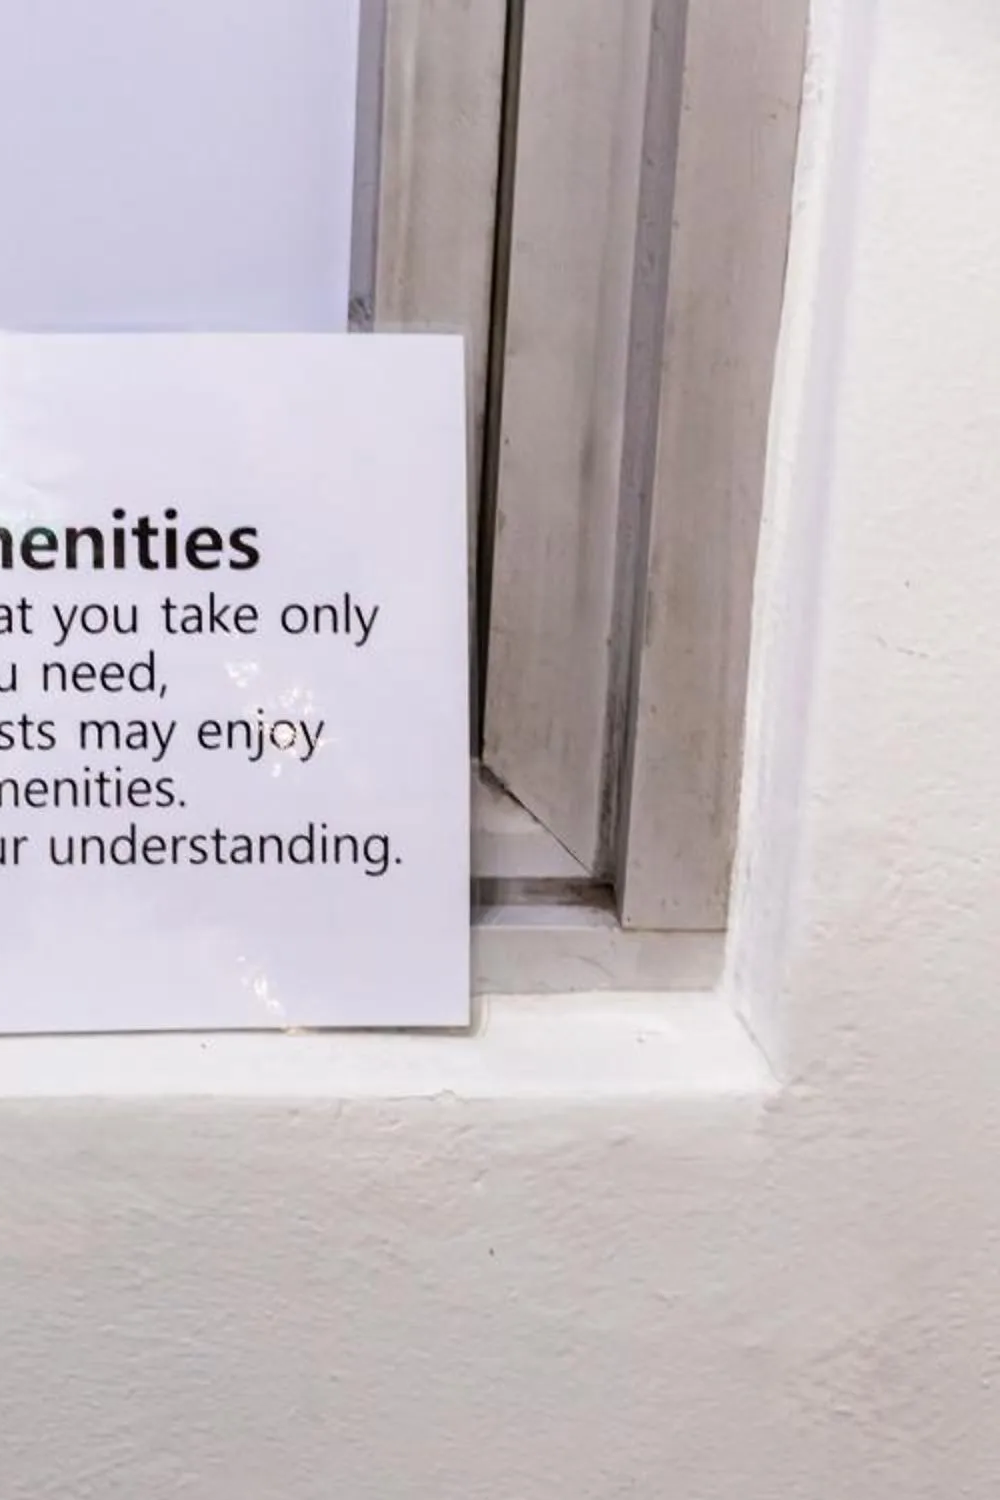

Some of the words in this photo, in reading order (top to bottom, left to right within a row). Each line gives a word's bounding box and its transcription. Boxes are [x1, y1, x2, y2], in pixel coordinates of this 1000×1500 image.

[52, 603, 138, 647] you
[160, 591, 259, 636] take
[280, 591, 379, 647] only
[42, 650, 167, 699] need,
[79, 719, 177, 763] may
[197, 708, 325, 763] enjoy
[49, 824, 402, 877] understanding.
